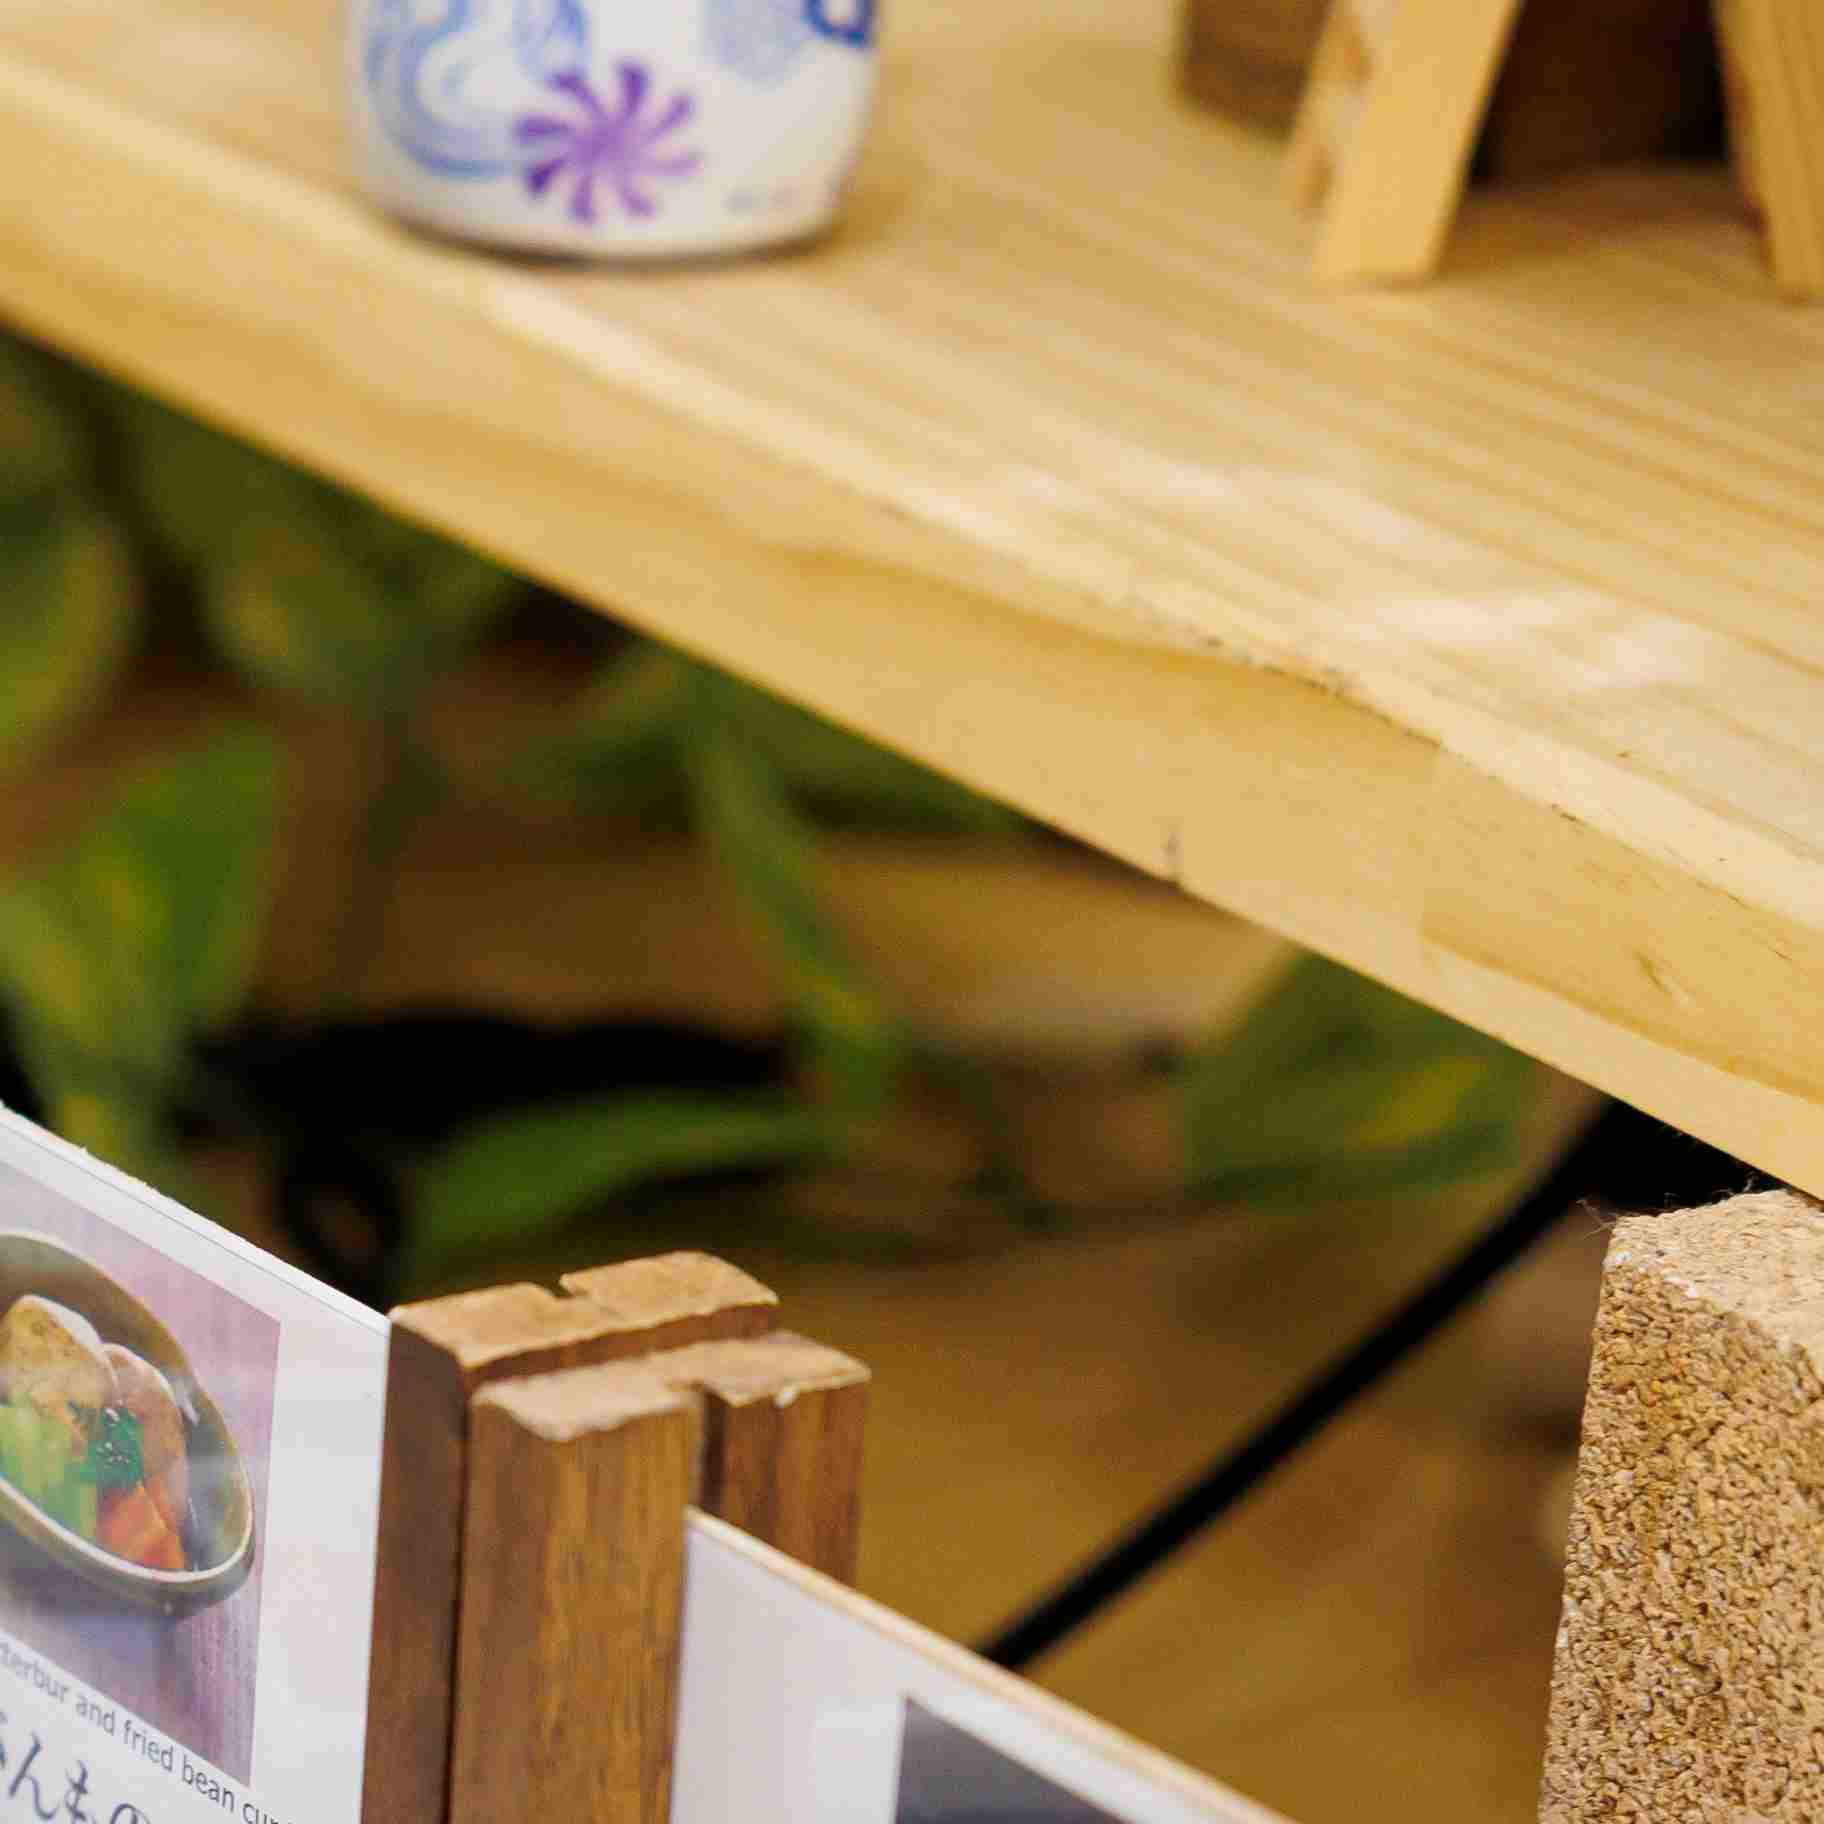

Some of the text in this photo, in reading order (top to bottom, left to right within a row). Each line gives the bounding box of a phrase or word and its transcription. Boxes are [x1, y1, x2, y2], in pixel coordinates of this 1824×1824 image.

[75, 1695, 115, 1736] and
[124, 1719, 174, 1773] fried
[181, 1754, 236, 1813] bean
